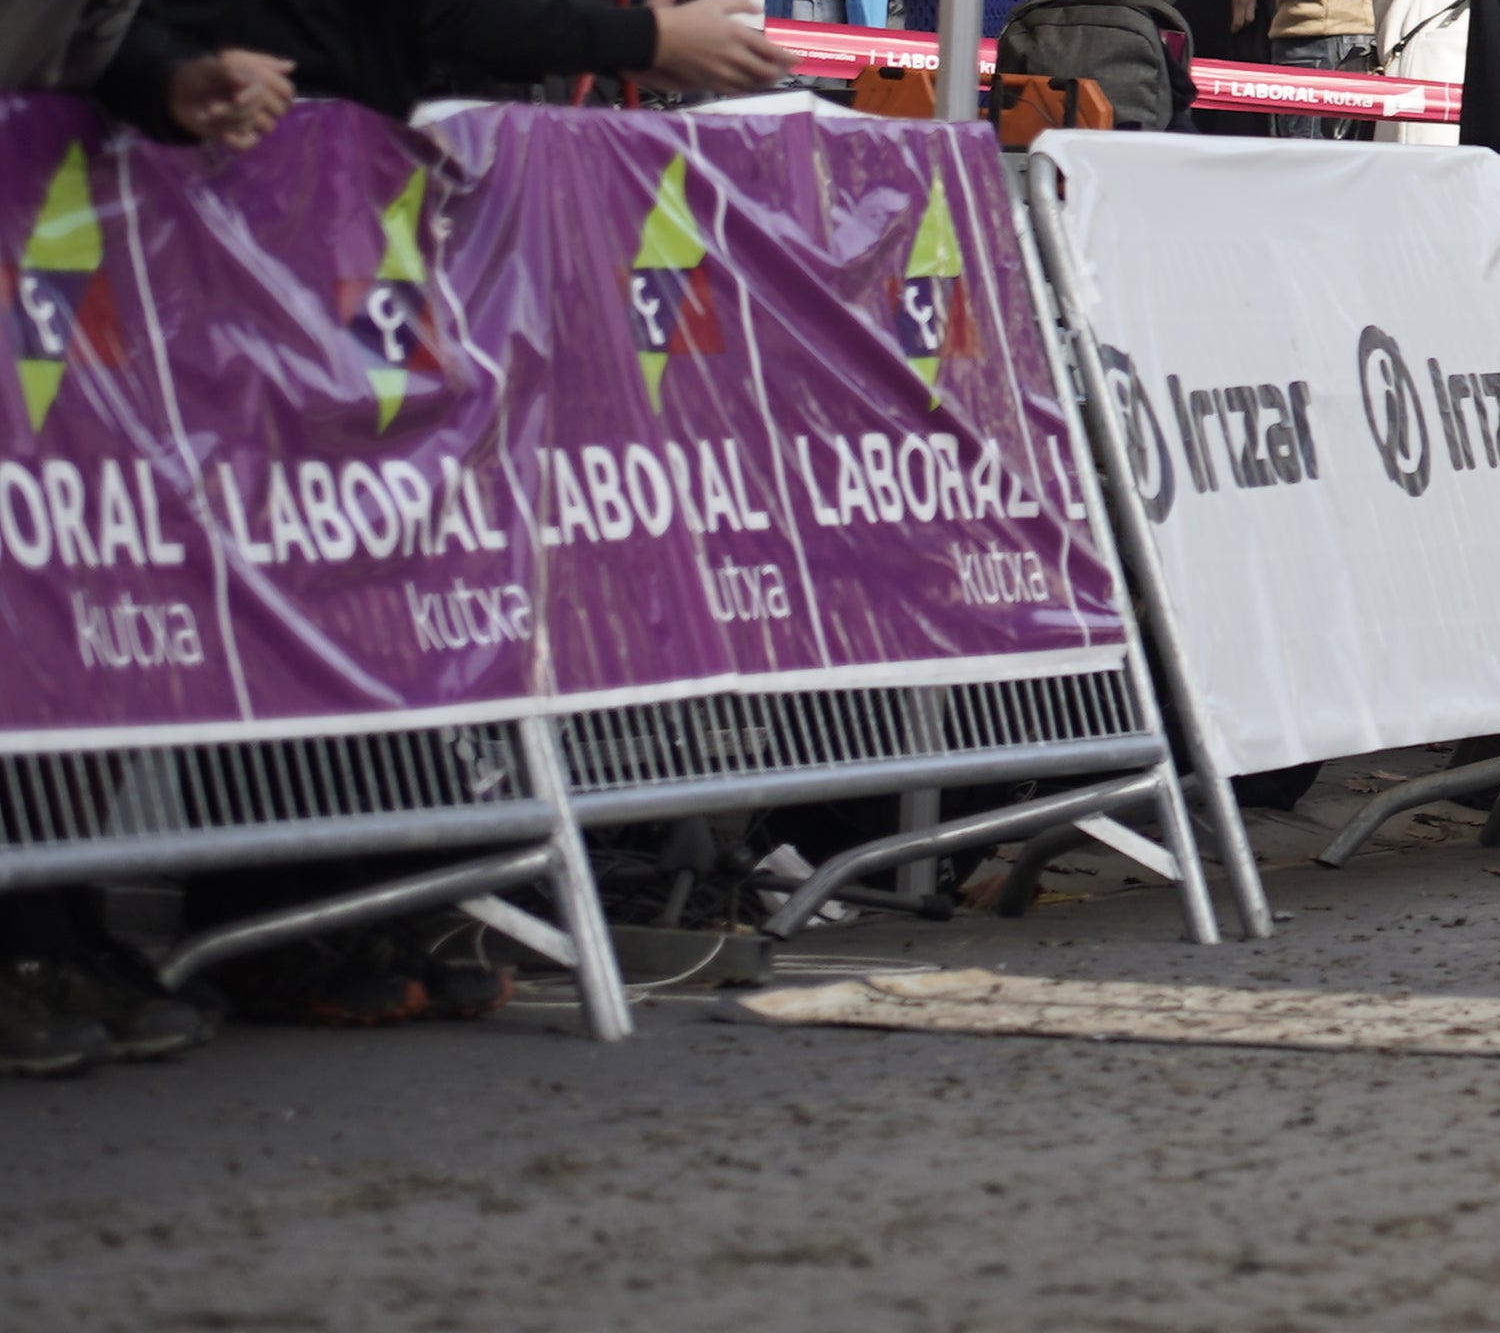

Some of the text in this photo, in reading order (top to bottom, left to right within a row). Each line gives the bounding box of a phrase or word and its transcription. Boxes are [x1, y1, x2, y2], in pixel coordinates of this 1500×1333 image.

[1231, 81, 1375, 109] LABORAL kutxa
[1165, 373, 1320, 495] Irizar
[0, 457, 186, 569] ORAL
[219, 455, 508, 563] LABORAL
[72, 540, 1051, 669] kutxa kutxa utxa kutxa
